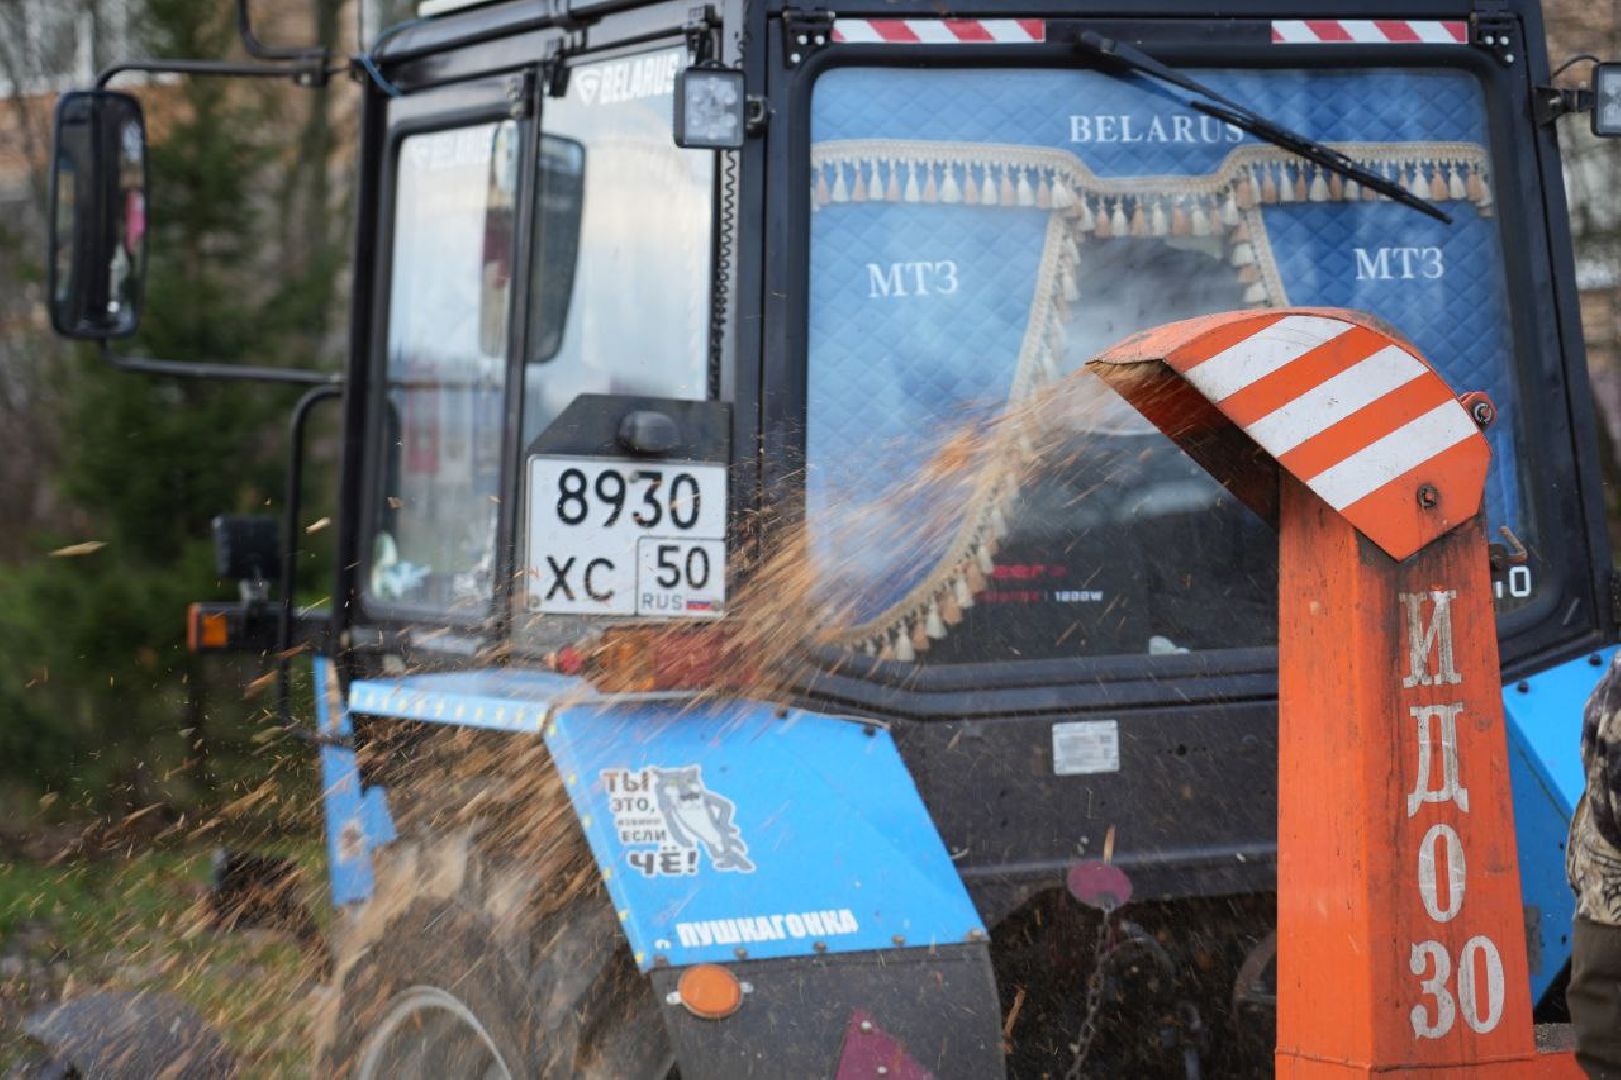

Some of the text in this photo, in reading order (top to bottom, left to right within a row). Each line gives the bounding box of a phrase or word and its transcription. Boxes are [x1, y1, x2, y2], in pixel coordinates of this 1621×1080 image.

[1069, 114, 1244, 144] BELARUS
[865, 260, 960, 298] МТЗ
[1352, 246, 1445, 280] МТЗ
[556, 467, 701, 530] 8930
[544, 554, 615, 602] ХС
[656, 544, 710, 589] 50
[641, 592, 683, 611] RUS
[603, 771, 649, 793] ТЫ
[611, 796, 656, 813] ЭТО,
[621, 829, 668, 842] ЕСЛИ
[628, 846, 698, 875] ЧЁ!
[676, 908, 860, 949] ПУШКАГОНКА
[1409, 935, 1505, 1039] 30
